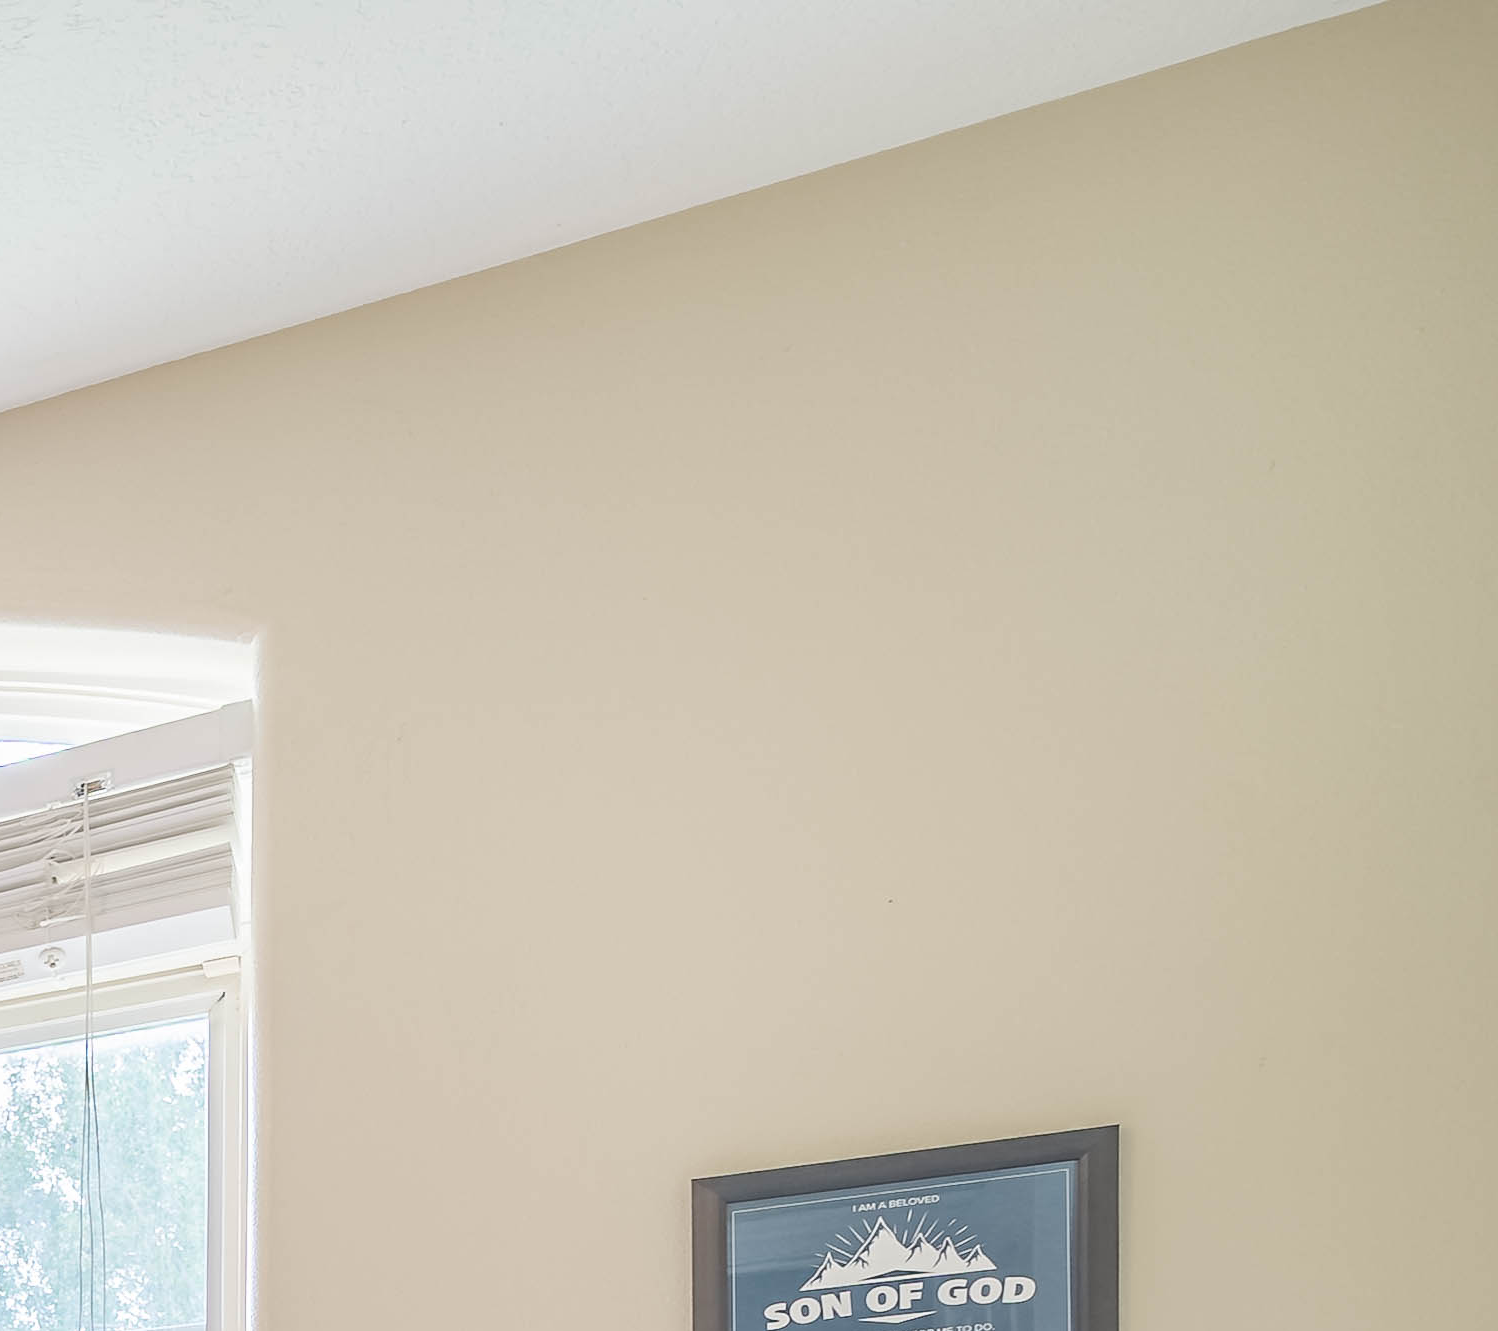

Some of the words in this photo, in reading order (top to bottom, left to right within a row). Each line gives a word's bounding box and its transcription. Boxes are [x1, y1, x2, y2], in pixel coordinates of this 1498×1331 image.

[851, 1204, 856, 1213] I
[856, 1202, 876, 1213] AM
[876, 1200, 887, 1210] A
[887, 1193, 940, 1209] BELOVED
[763, 1290, 853, 1331] SON
[865, 1280, 924, 1314] OF
[936, 1275, 1037, 1306] GOD
[973, 1321, 995, 1331] DO.
